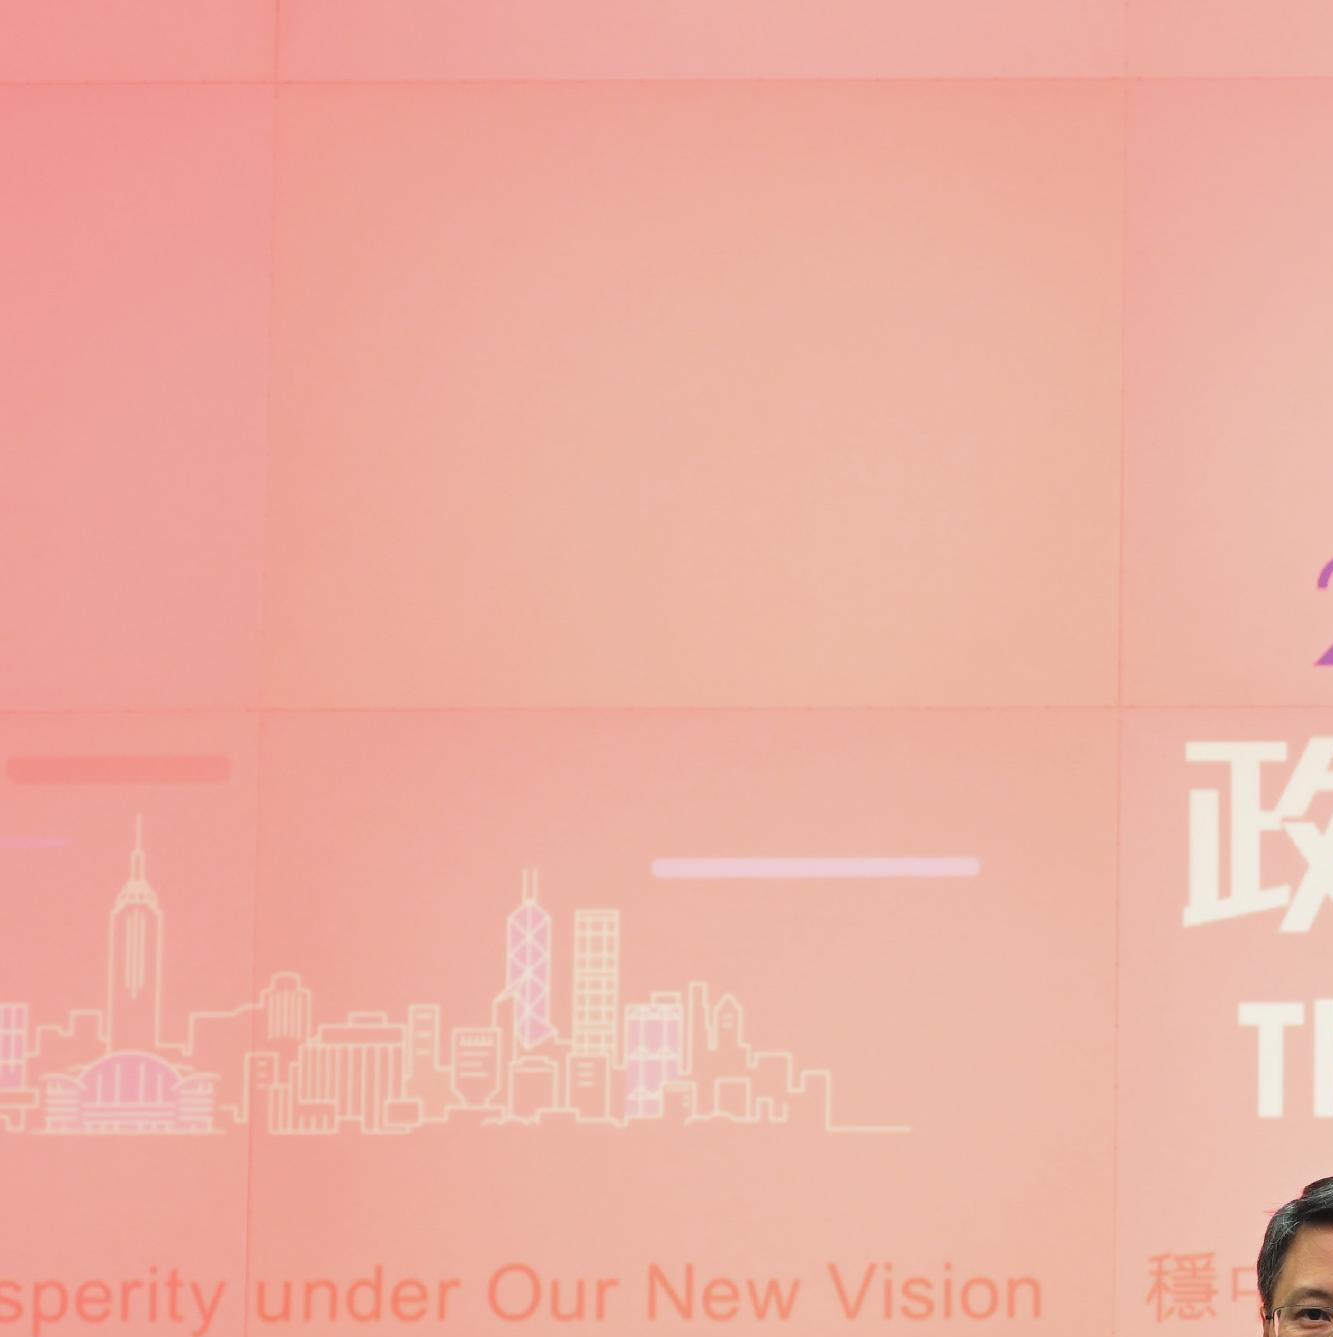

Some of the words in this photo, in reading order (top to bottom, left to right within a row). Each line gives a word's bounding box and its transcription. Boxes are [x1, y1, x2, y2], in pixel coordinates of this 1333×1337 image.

[255, 1265, 461, 1321] under
[487, 1264, 619, 1321] Our
[646, 1264, 800, 1320] New
[828, 1262, 1042, 1320] Vision
